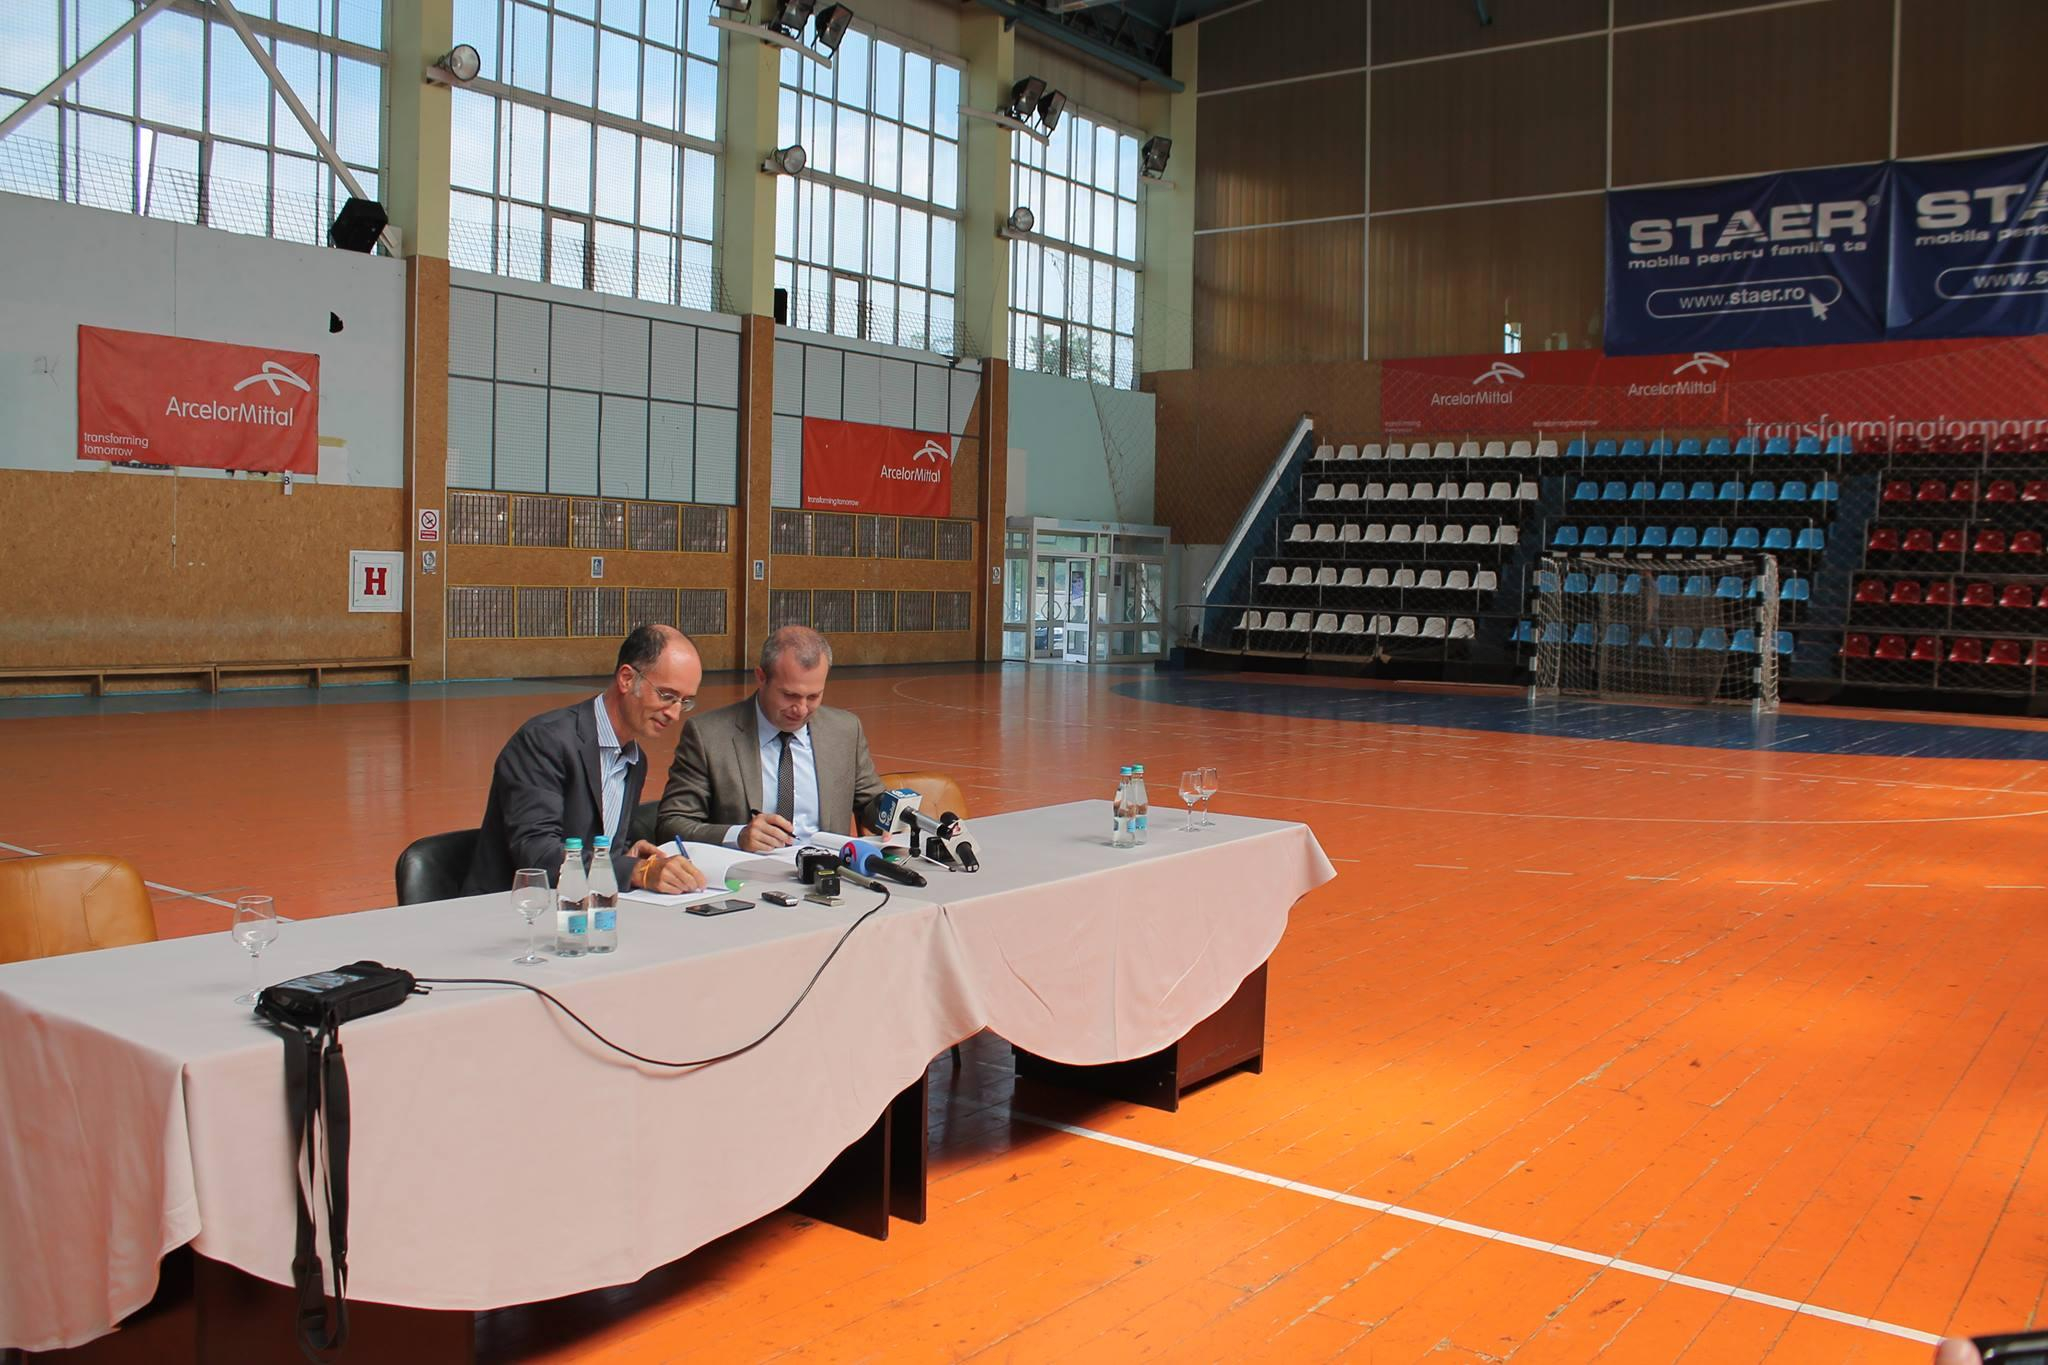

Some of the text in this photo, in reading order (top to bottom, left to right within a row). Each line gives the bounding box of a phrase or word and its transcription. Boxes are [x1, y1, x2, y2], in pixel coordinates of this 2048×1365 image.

[1915, 229, 1991, 247] mobila
[1628, 254, 1690, 270] mobila
[1697, 247, 1763, 267] pentru
[1843, 239, 1868, 253] ta
[1679, 286, 1806, 310] www.staer.ro
[1627, 380, 1717, 397] ArcelorMittal
[1430, 391, 1513, 407] ArcelorMittal
[165, 396, 294, 426] ArcelorMittal
[83, 432, 149, 449] transforming
[83, 445, 134, 457] tomorrow
[880, 464, 941, 483] ArcelorMittal
[364, 567, 387, 595] H
